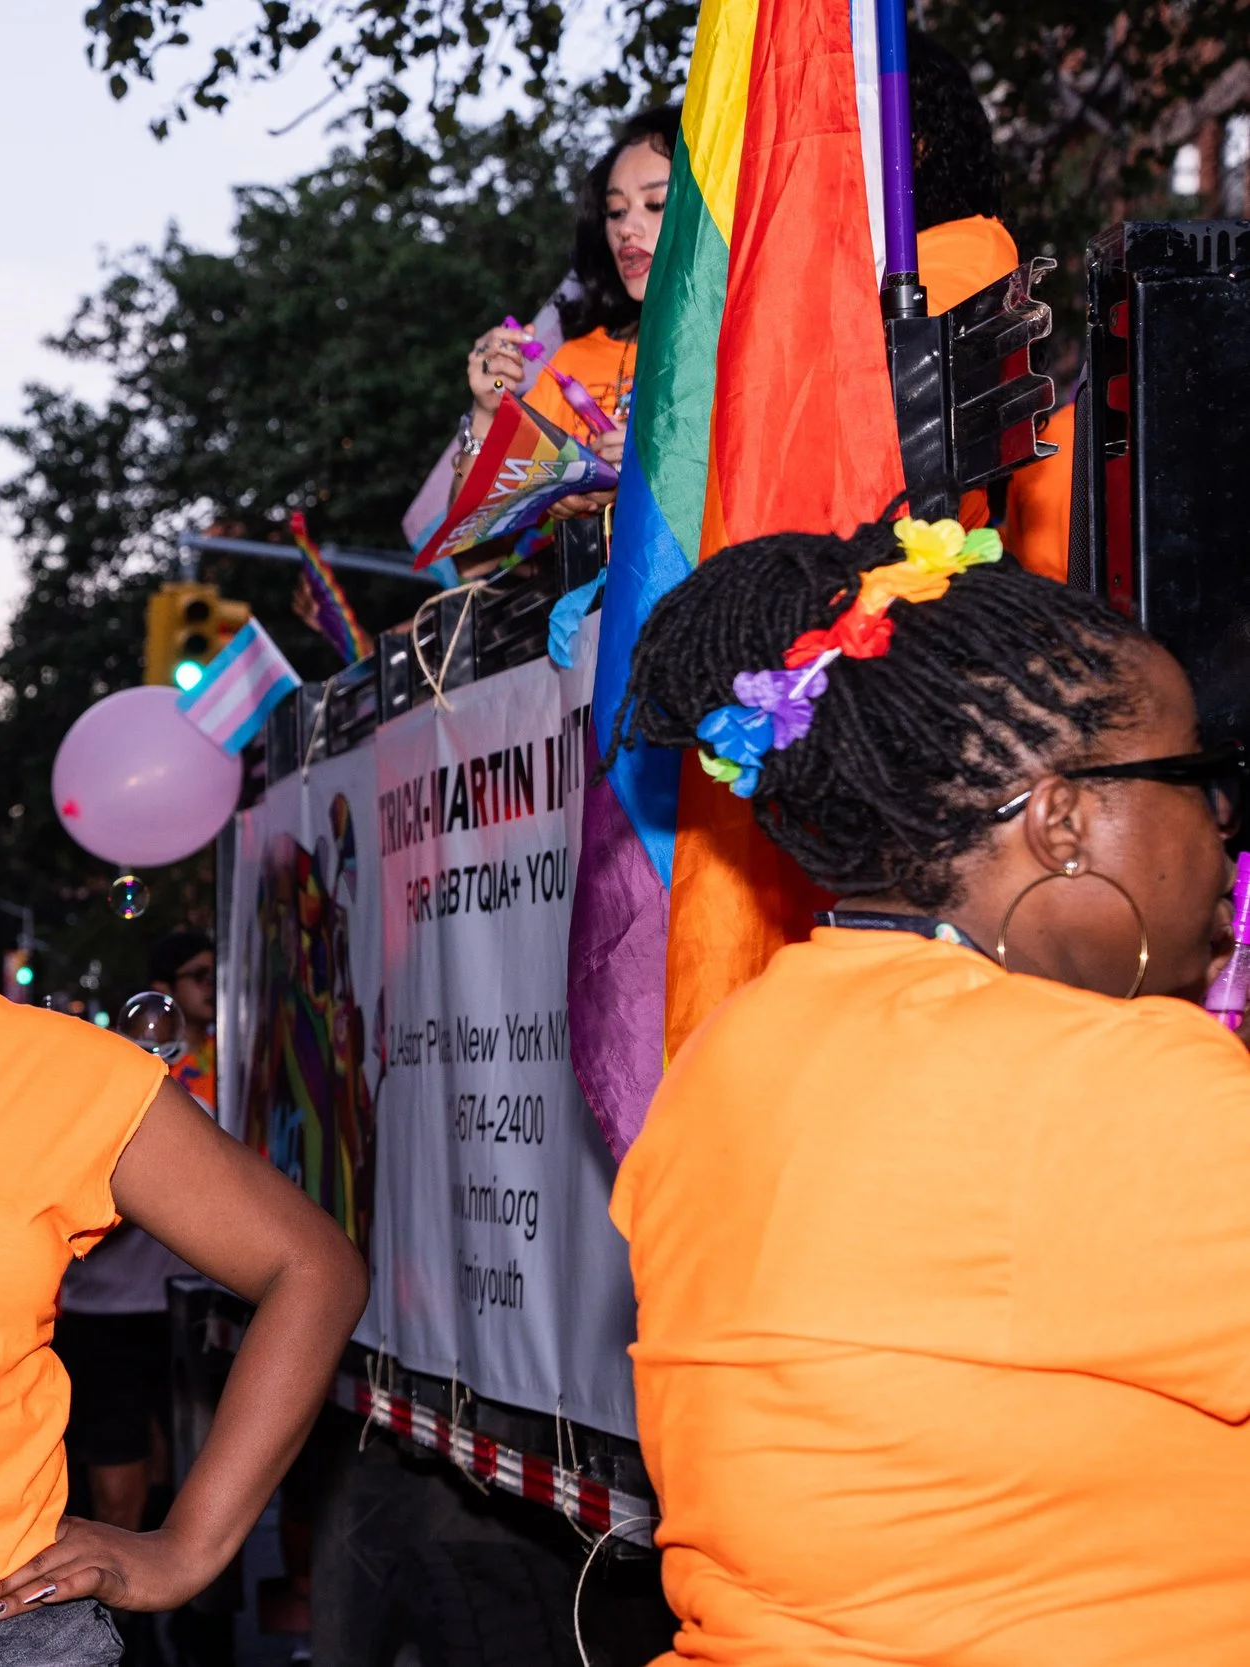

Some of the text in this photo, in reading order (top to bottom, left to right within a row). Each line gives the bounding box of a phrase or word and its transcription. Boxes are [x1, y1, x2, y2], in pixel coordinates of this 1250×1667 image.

[406, 875, 432, 926] FOR
[456, 1014, 500, 1063] New
[505, 1011, 543, 1063] York
